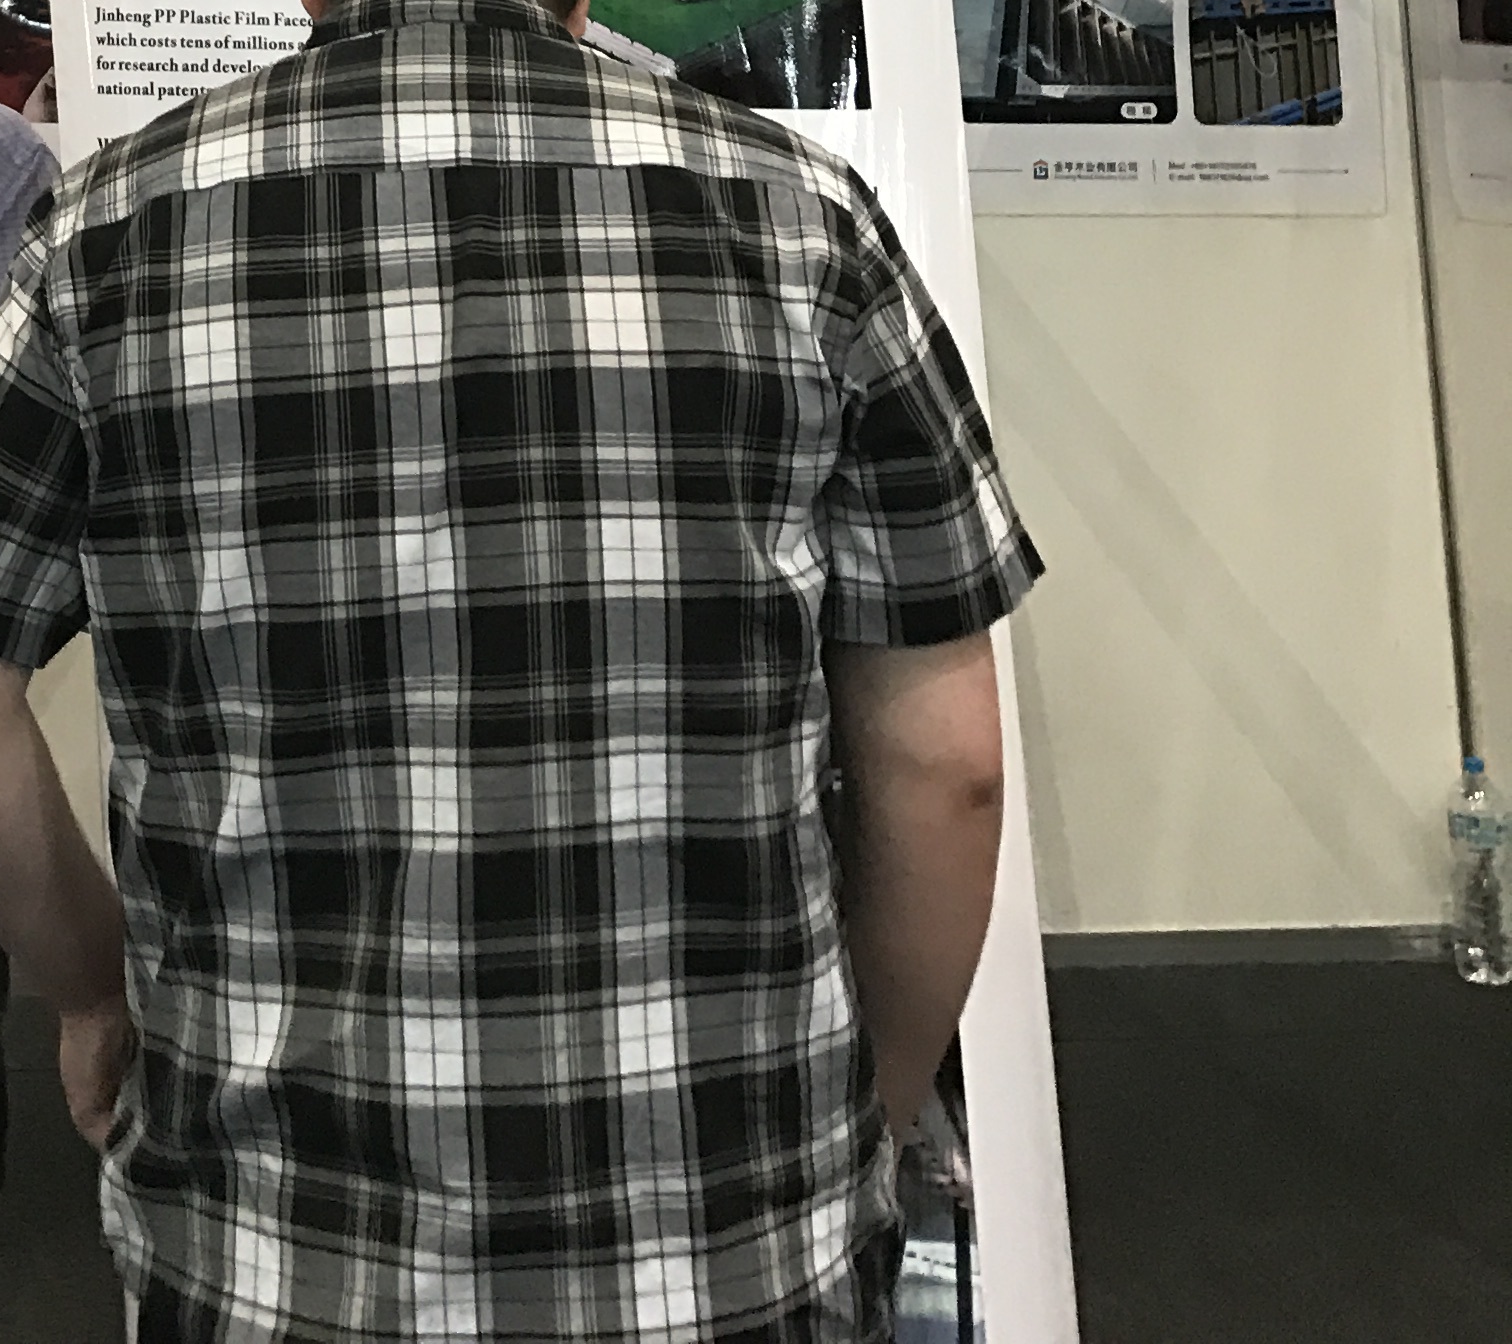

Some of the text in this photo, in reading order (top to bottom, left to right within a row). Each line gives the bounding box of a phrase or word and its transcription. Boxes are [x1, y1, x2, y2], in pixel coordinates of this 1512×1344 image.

[94, 7, 152, 28] Jinheng
[154, 9, 177, 24] PP
[179, 9, 231, 26] Plastic
[234, 10, 270, 26] Film
[96, 32, 137, 48] which
[140, 35, 177, 48] costs
[180, 36, 211, 49] tens
[214, 34, 231, 49] of
[232, 35, 295, 51] millions
[96, 55, 116, 70] for
[118, 57, 179, 73] research
[182, 58, 209, 73] and
[97, 81, 212, 100] national patent
